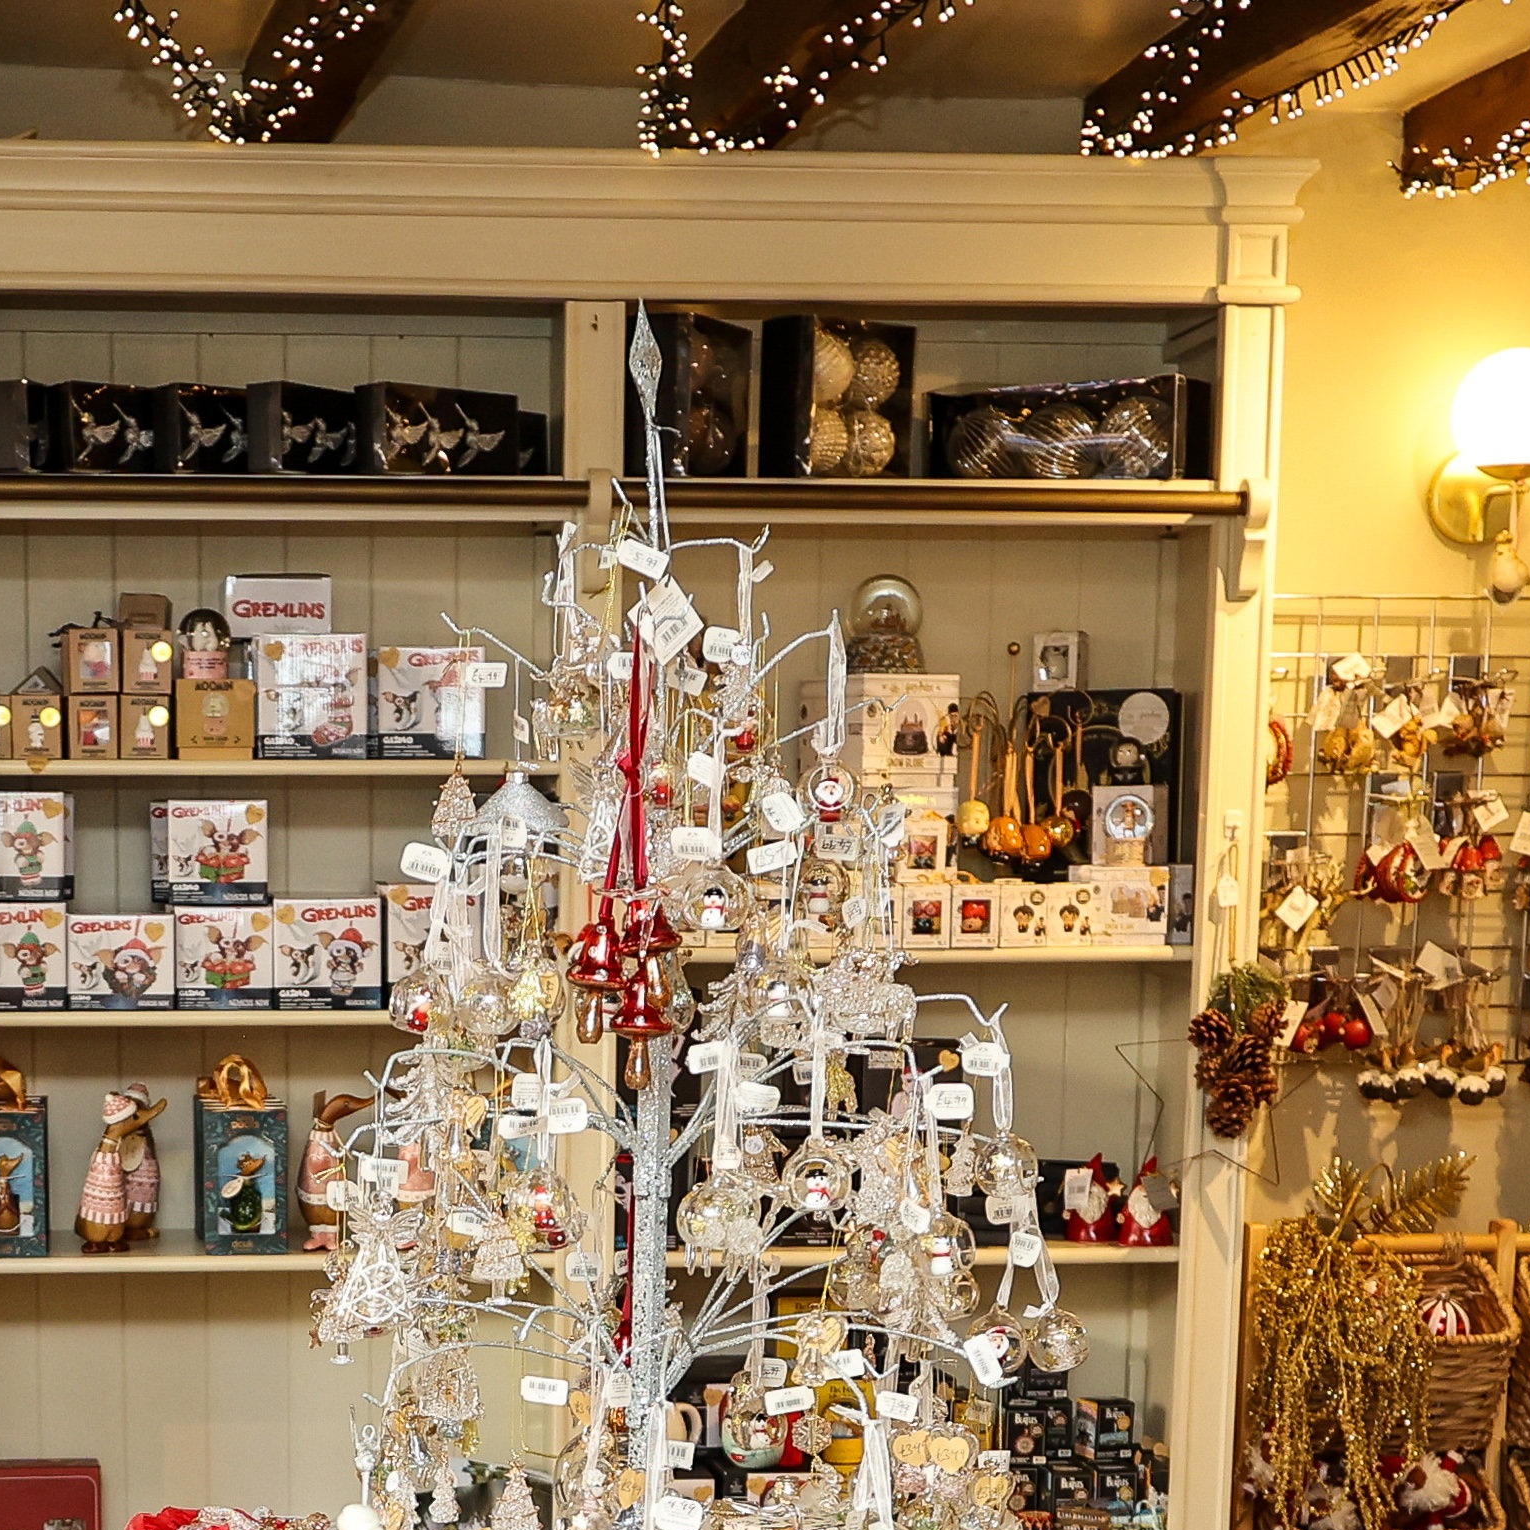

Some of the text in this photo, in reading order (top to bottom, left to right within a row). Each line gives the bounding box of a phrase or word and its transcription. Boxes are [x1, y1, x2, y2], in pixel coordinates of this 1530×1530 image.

[232, 599, 326, 620] GREMLINS
[301, 905, 377, 923] GREMLINS
[70, 920, 132, 934] GREMLINS
